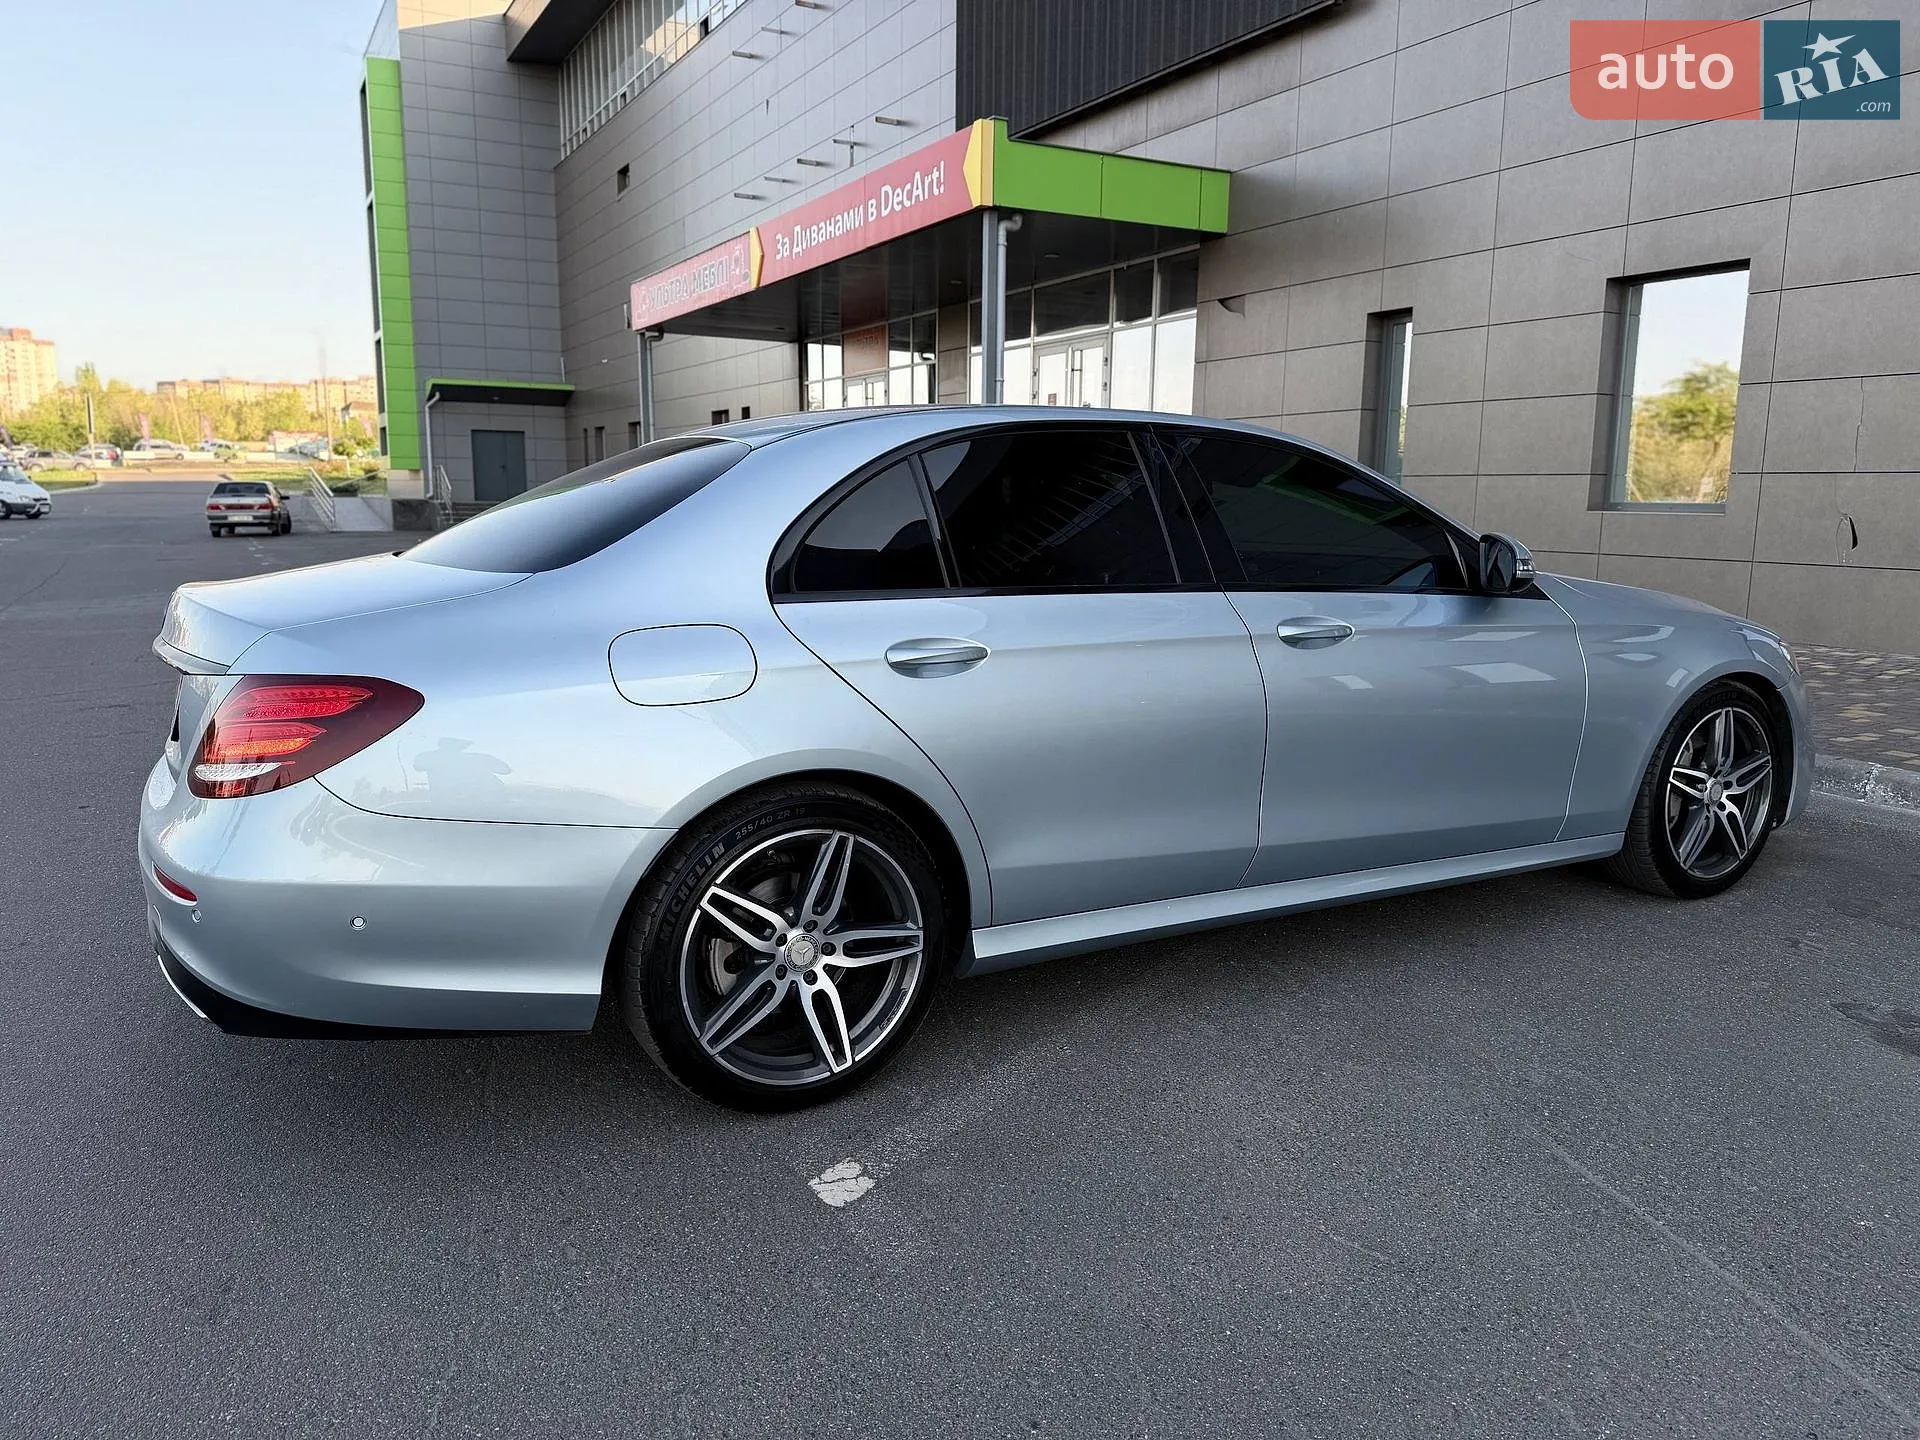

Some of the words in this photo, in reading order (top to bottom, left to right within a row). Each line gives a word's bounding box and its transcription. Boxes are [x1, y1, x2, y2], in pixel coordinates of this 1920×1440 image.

[775, 232, 790, 260] За
[792, 203, 864, 260] Диванами
[868, 198, 877, 223] в
[880, 160, 945, 218] DecArt!
[660, 842, 726, 942] MICHELIN
[735, 815, 773, 840] 255/40
[776, 809, 791, 820] ZR
